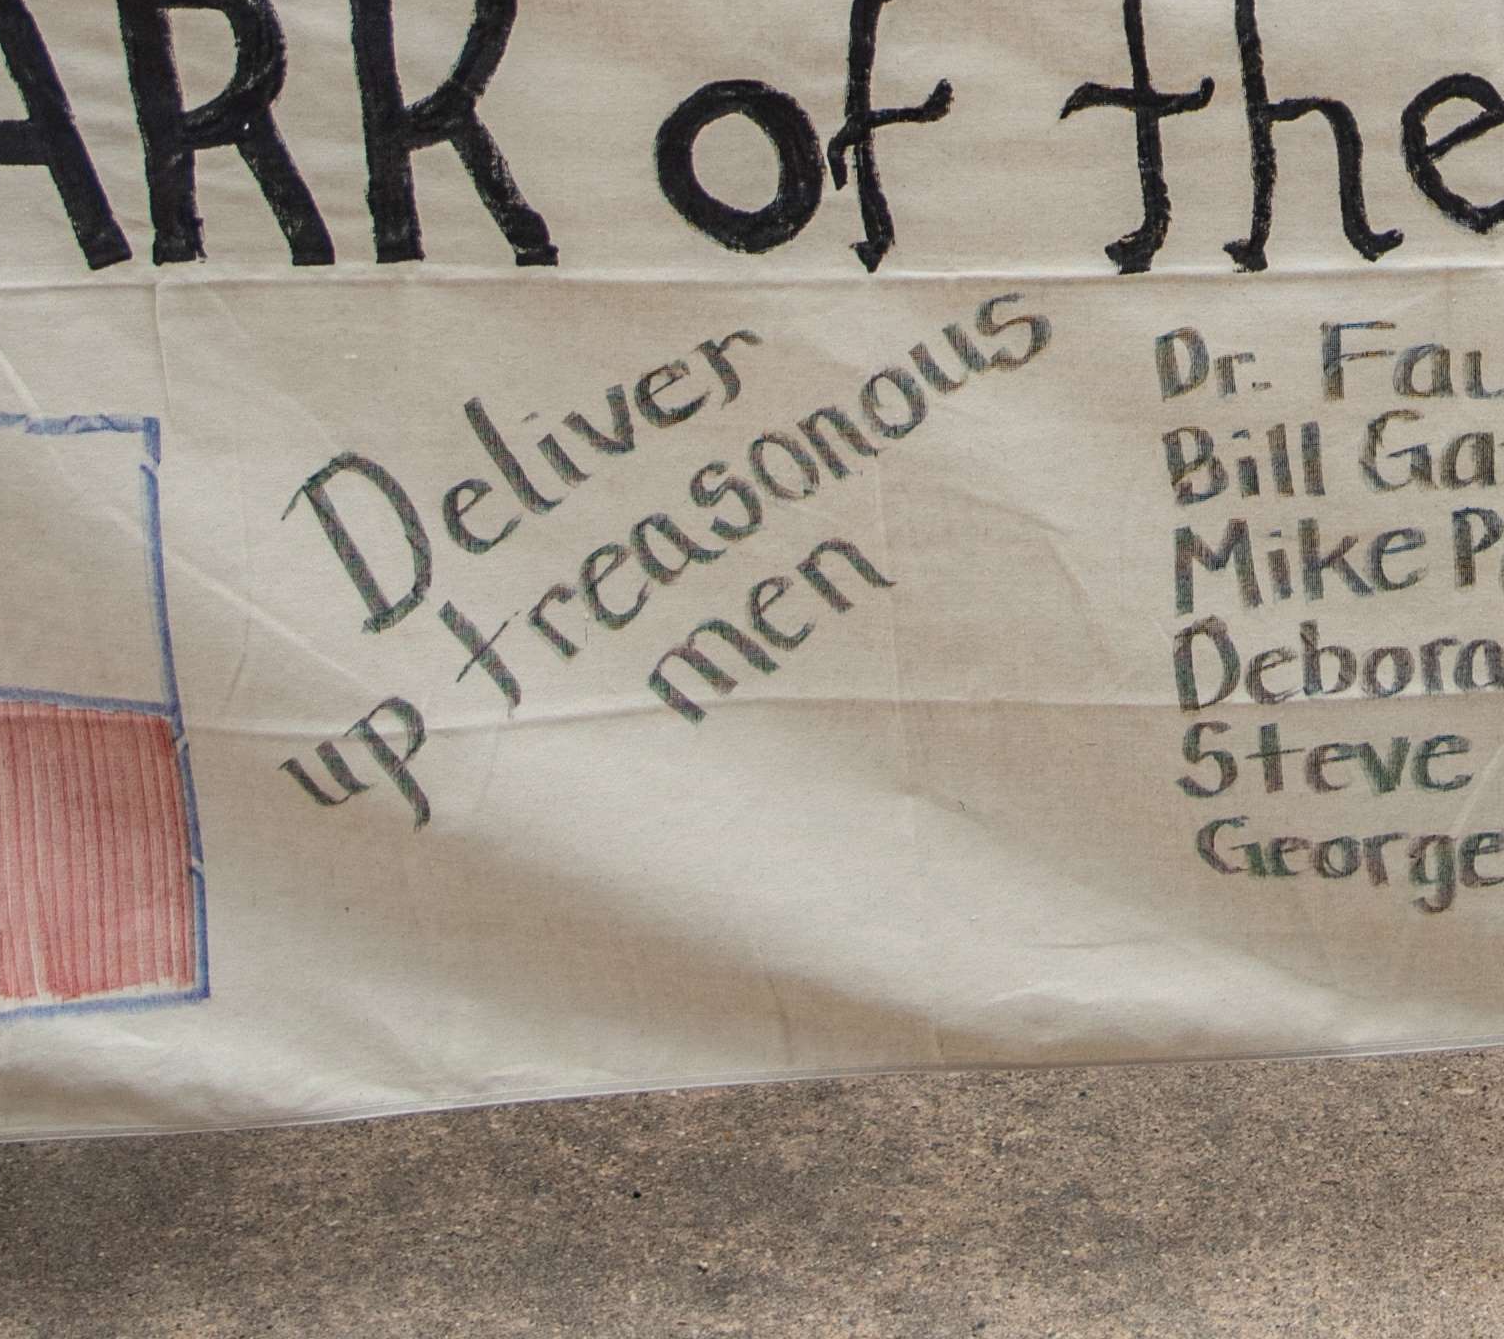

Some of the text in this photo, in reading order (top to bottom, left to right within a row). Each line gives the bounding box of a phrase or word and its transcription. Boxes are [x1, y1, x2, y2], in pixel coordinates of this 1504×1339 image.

[1156, 326, 1271, 401] Dr.
[281, 328, 762, 633] Deliver
[1161, 420, 1325, 506] Bill
[279, 292, 1052, 831] up treasonous
[1173, 517, 1428, 615] Mike
[647, 537, 897, 721] men
[1176, 721, 1473, 797] Steve
